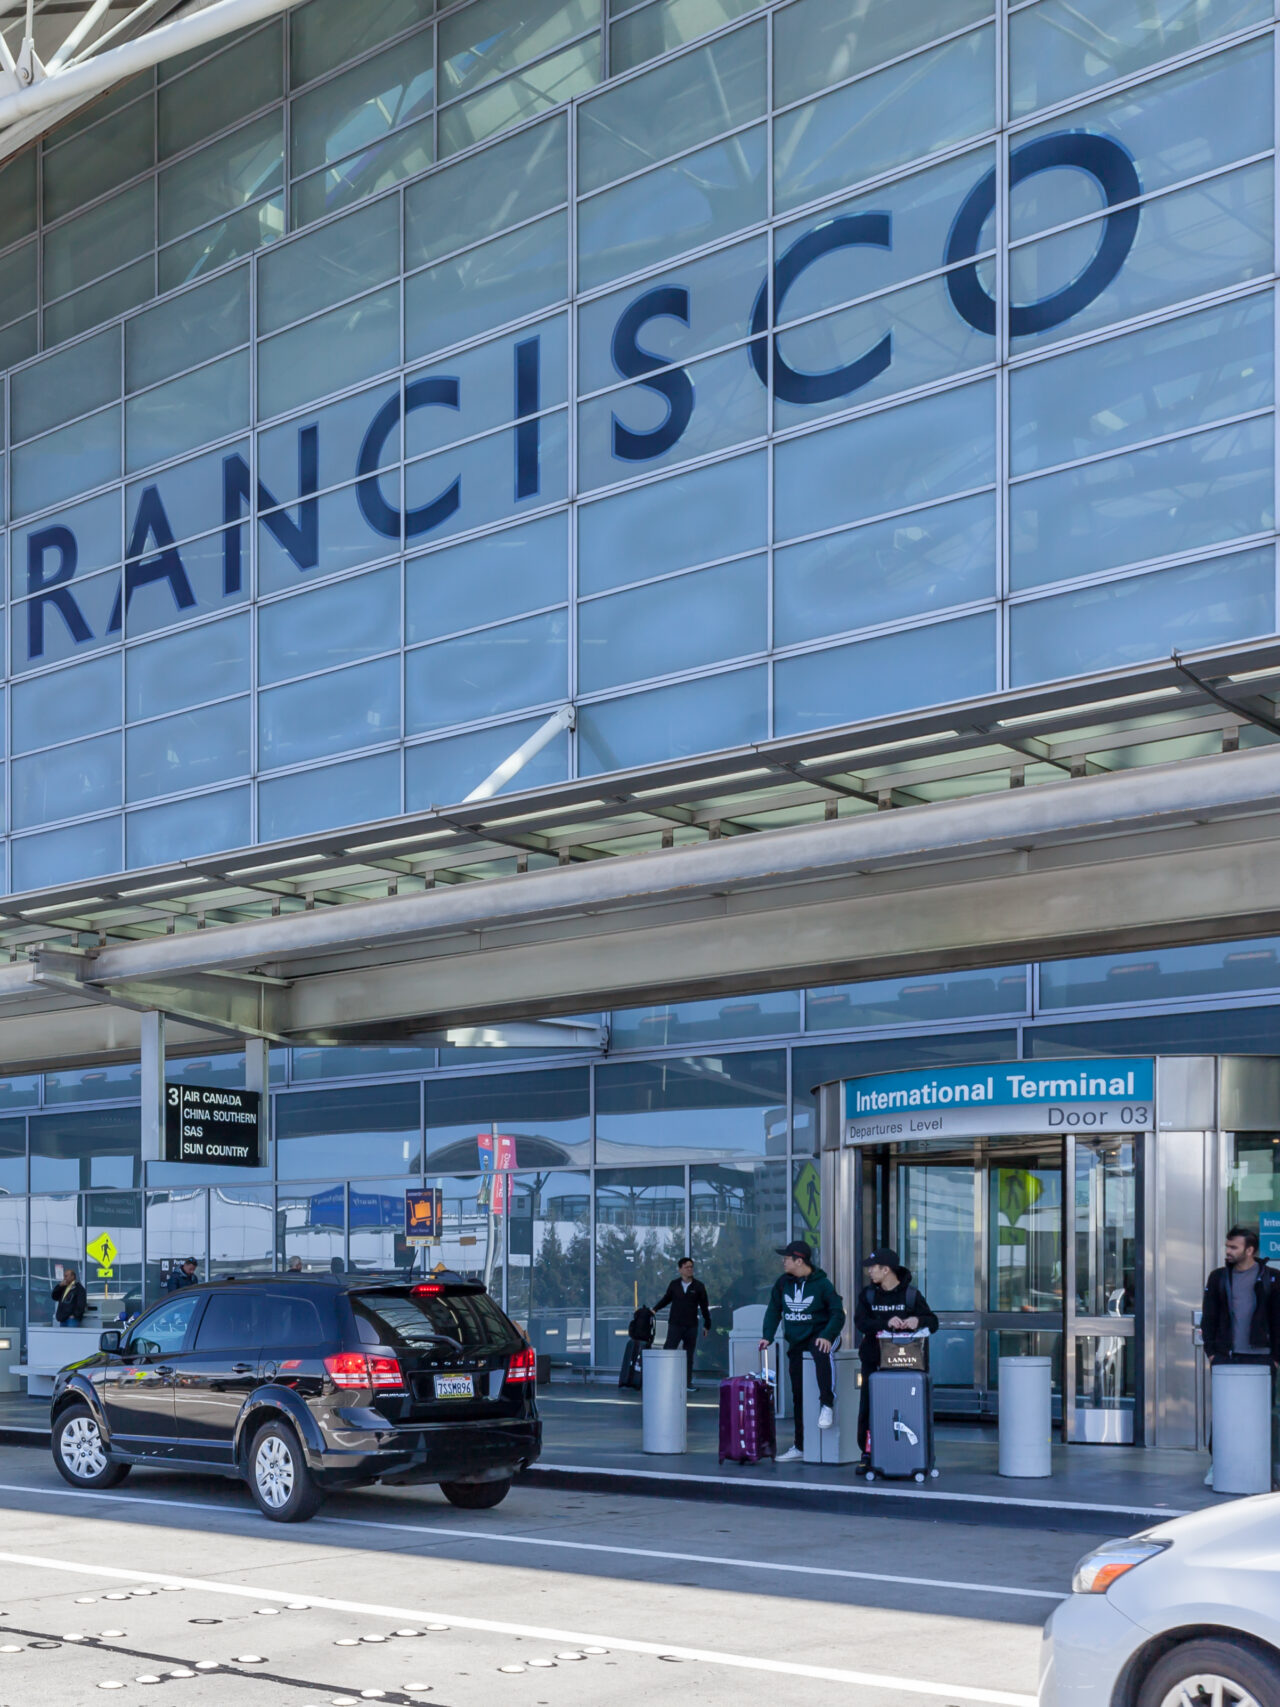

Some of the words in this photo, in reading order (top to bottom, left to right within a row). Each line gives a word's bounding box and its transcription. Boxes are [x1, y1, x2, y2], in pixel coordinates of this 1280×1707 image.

[168, 1087, 179, 1106] 3
[183, 1091, 200, 1102] AIR
[203, 1092, 242, 1106] CANADA
[856, 1077, 993, 1112] International
[1006, 1072, 1134, 1099] Terminal
[184, 1108, 211, 1120] CHINA
[213, 1110, 257, 1124] SOUTHERN
[1047, 1107, 1108, 1126] Door
[1120, 1106, 1148, 1125] 03
[184, 1126, 203, 1137] SAS
[850, 1123, 903, 1140] Departures
[910, 1117, 943, 1132] Level
[184, 1143, 203, 1155] SUN
[205, 1144, 249, 1158] COUNTRY
[785, 1313, 813, 1321] adidas
[437, 1382, 471, 1395] 7SSM896
